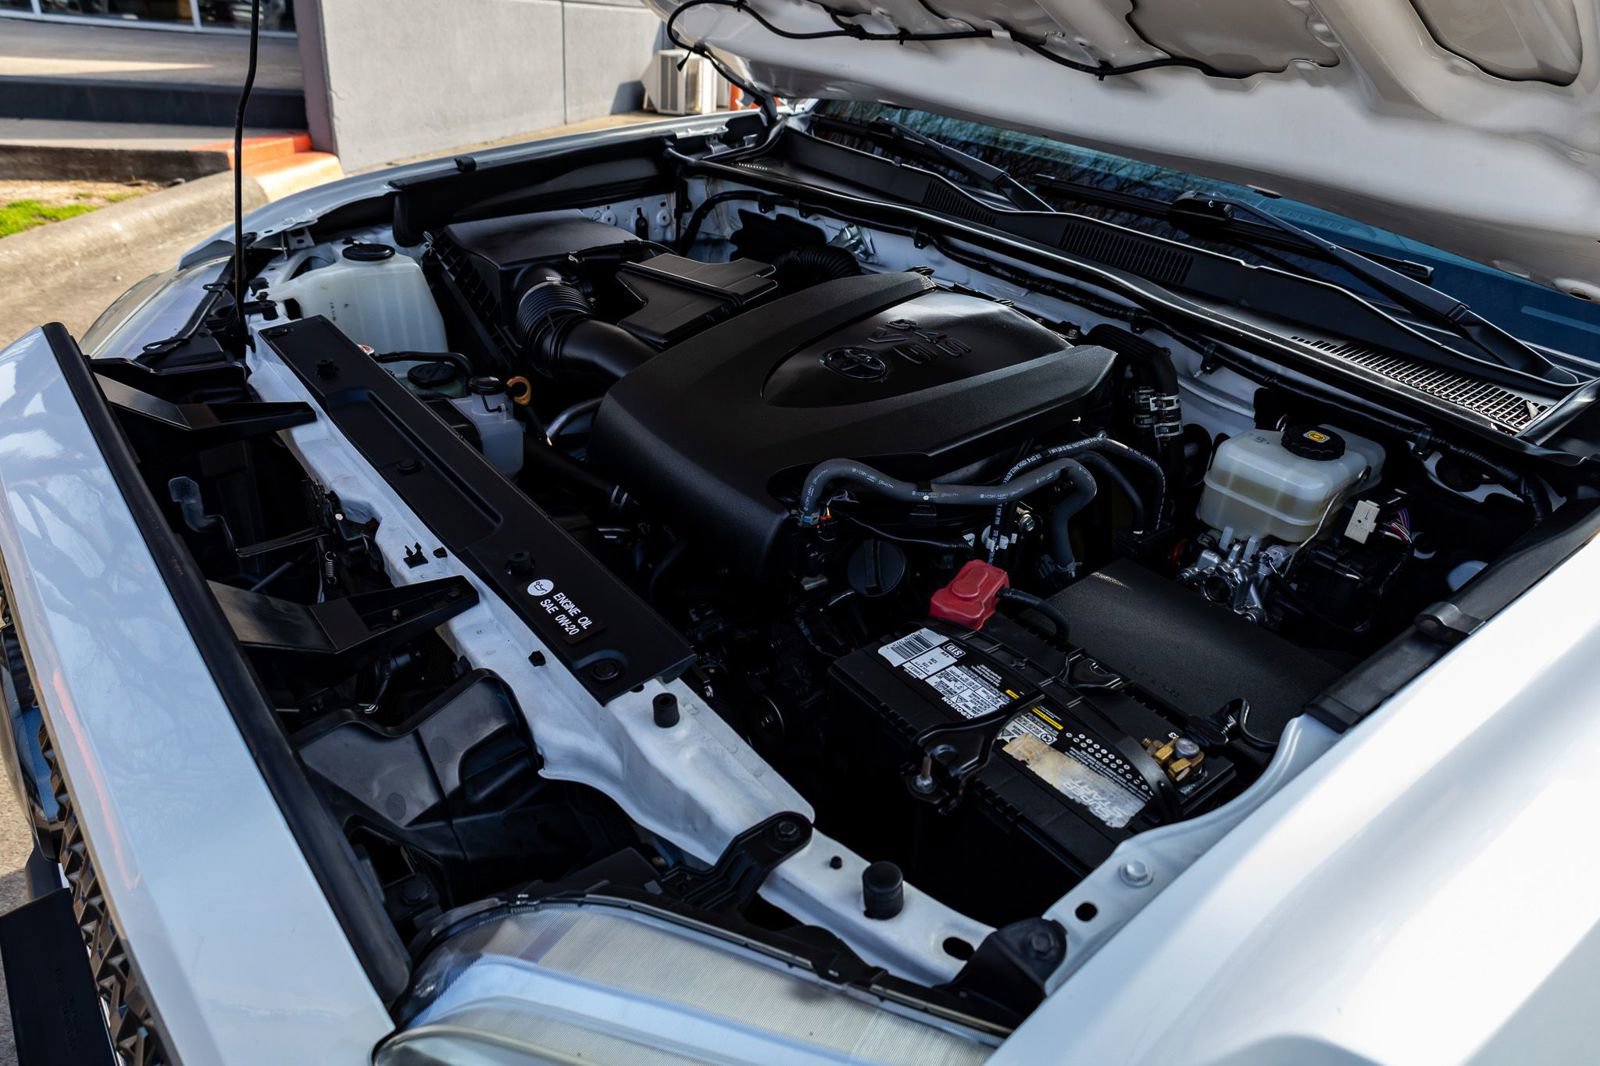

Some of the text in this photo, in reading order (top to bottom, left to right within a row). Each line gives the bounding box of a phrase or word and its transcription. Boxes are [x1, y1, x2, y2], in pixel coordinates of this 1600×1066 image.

[540, 599, 580, 636] SAE 0W-20
[553, 592, 592, 630] ENGINE OIL
[1063, 782, 1113, 819] SUPER
[1070, 779, 1126, 816] START
